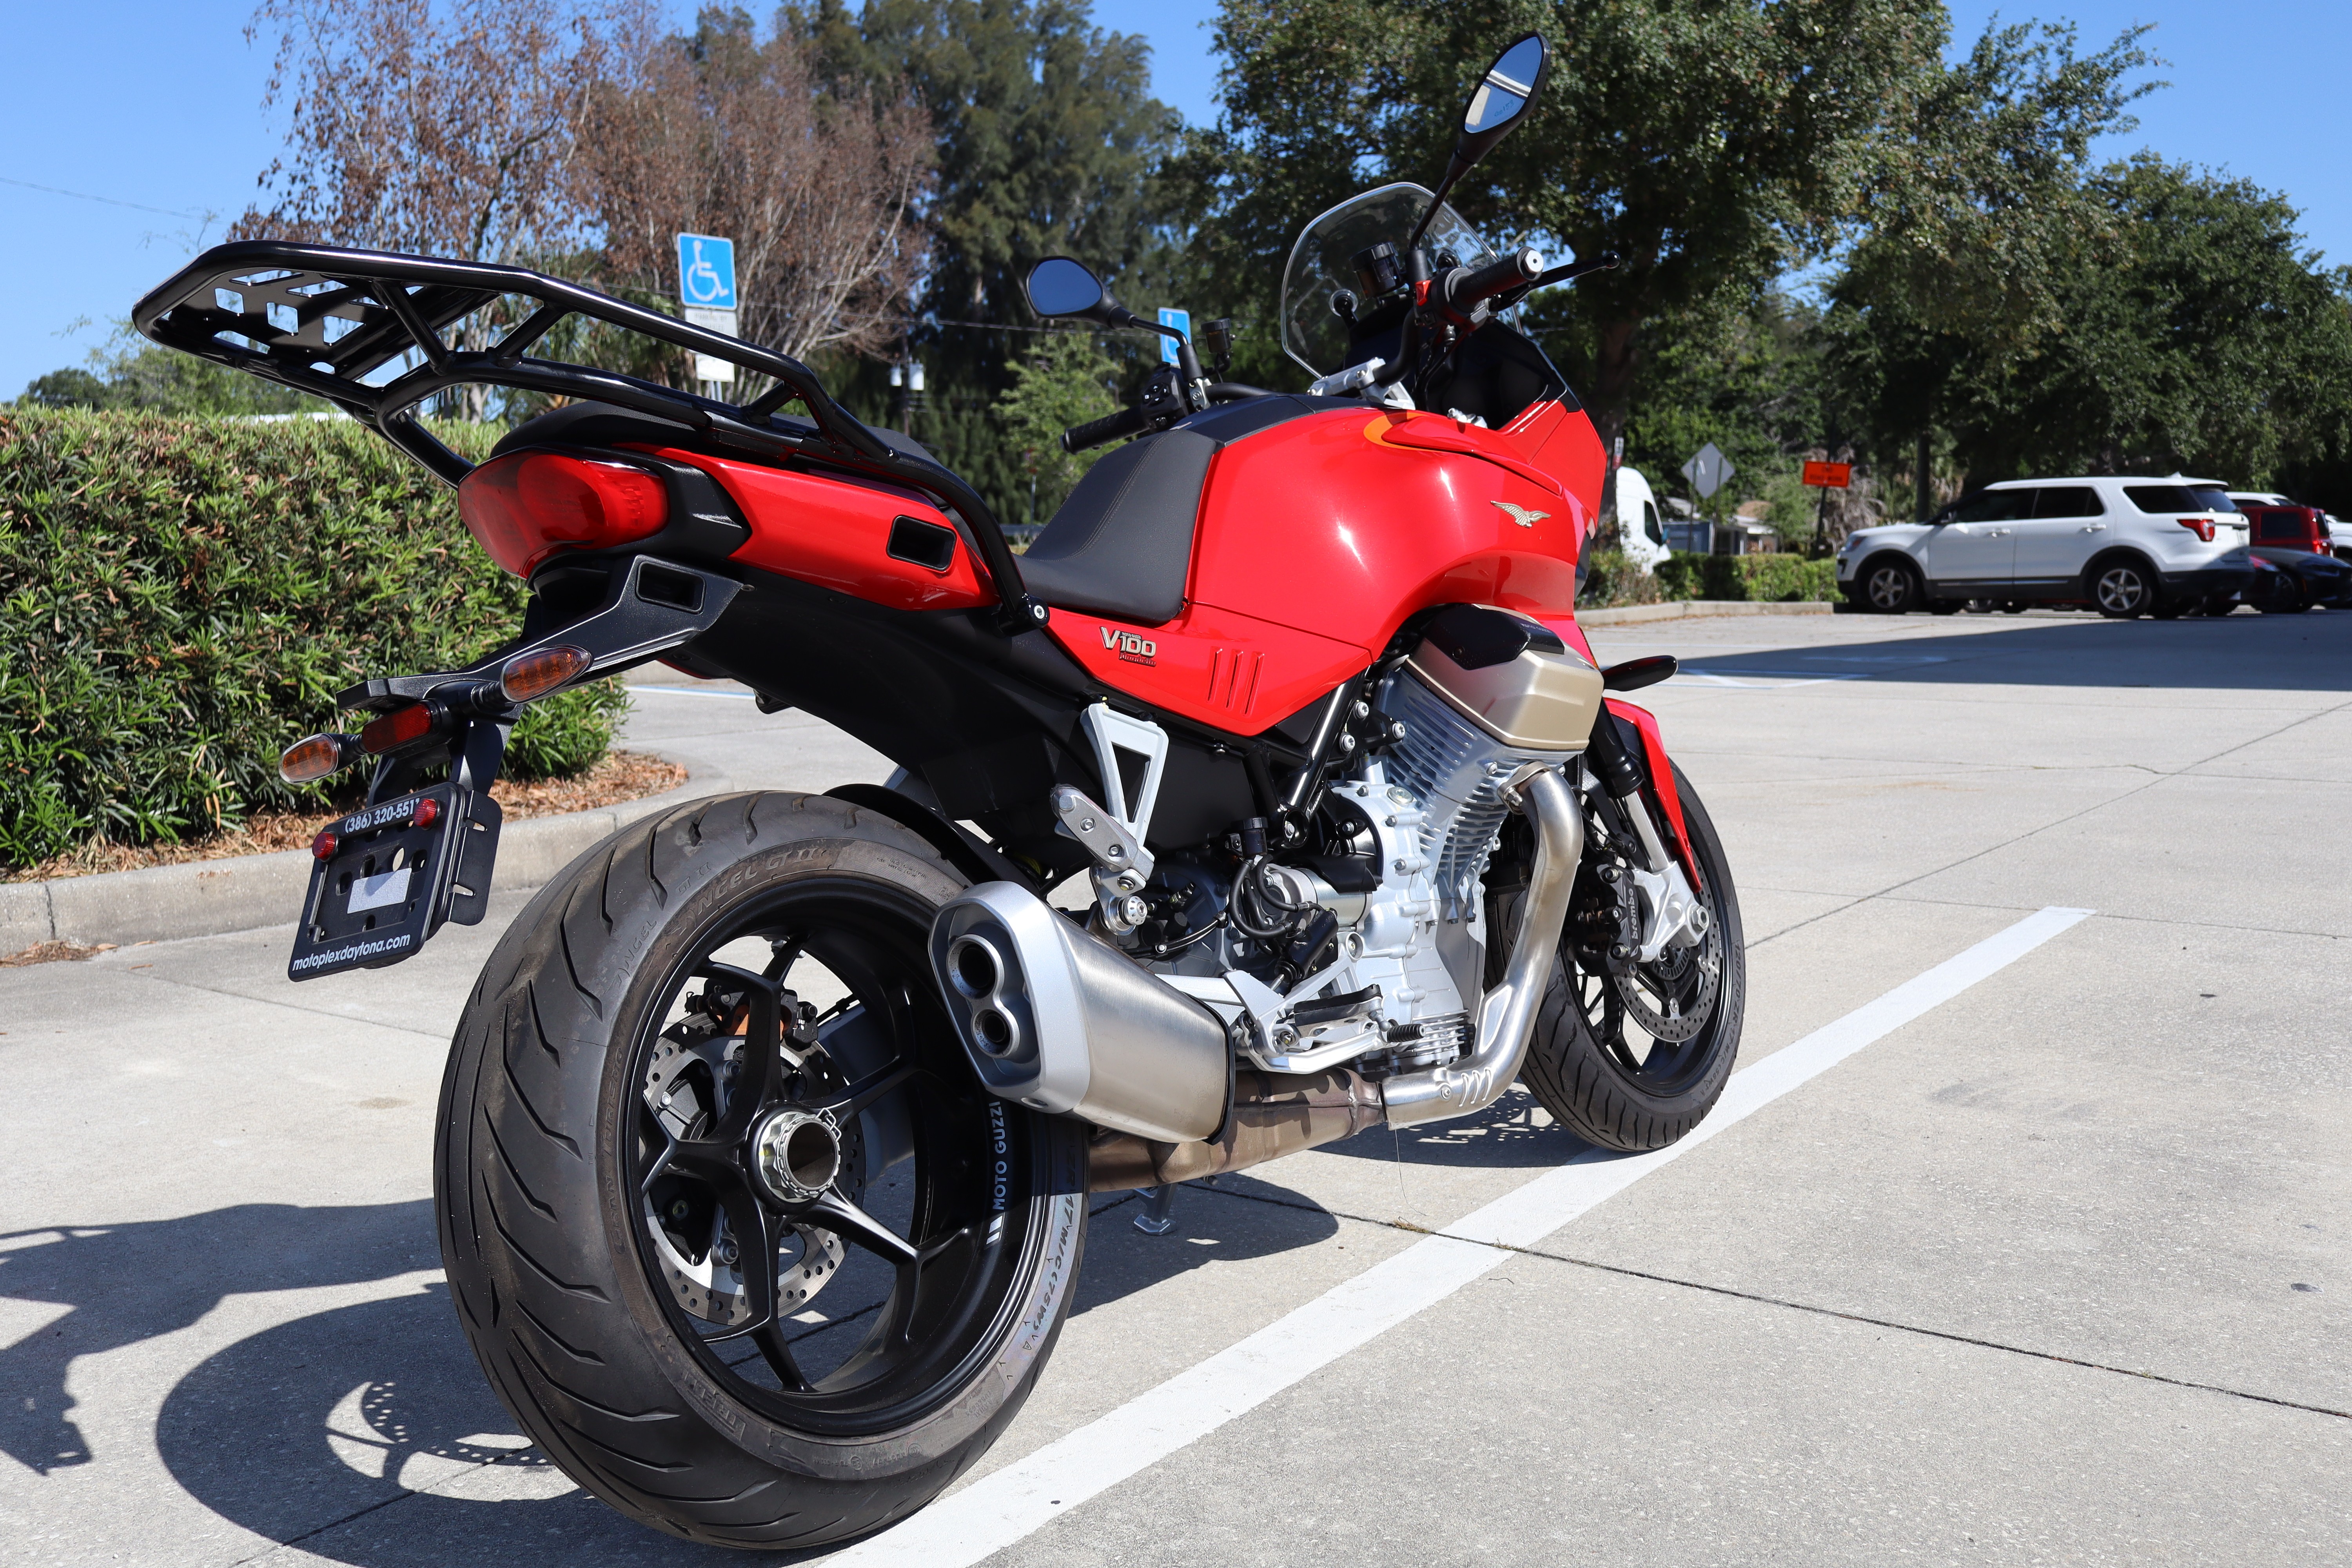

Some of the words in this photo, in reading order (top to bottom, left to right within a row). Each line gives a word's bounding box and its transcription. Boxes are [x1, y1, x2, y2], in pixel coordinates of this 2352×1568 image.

[1100, 626, 1156, 657] V100
[345, 813, 372, 834] (386)
[374, 798, 420, 826] 320-551
[765, 850, 793, 870] GT
[1628, 888, 1638, 939] brembo
[292, 933, 411, 971] motoplexdaytona.com
[1733, 1000, 1740, 1024] ZR
[1729, 1027, 1735, 1045] 17
[989, 1101, 1006, 1154] GUZZI
[993, 1161, 1007, 1210] MOTO
[1066, 1148, 1076, 1187] ZR
[1064, 1195, 1074, 1225] 17
[1054, 1226, 1068, 1270] M/C
[1033, 1271, 1058, 1331] (75W)
